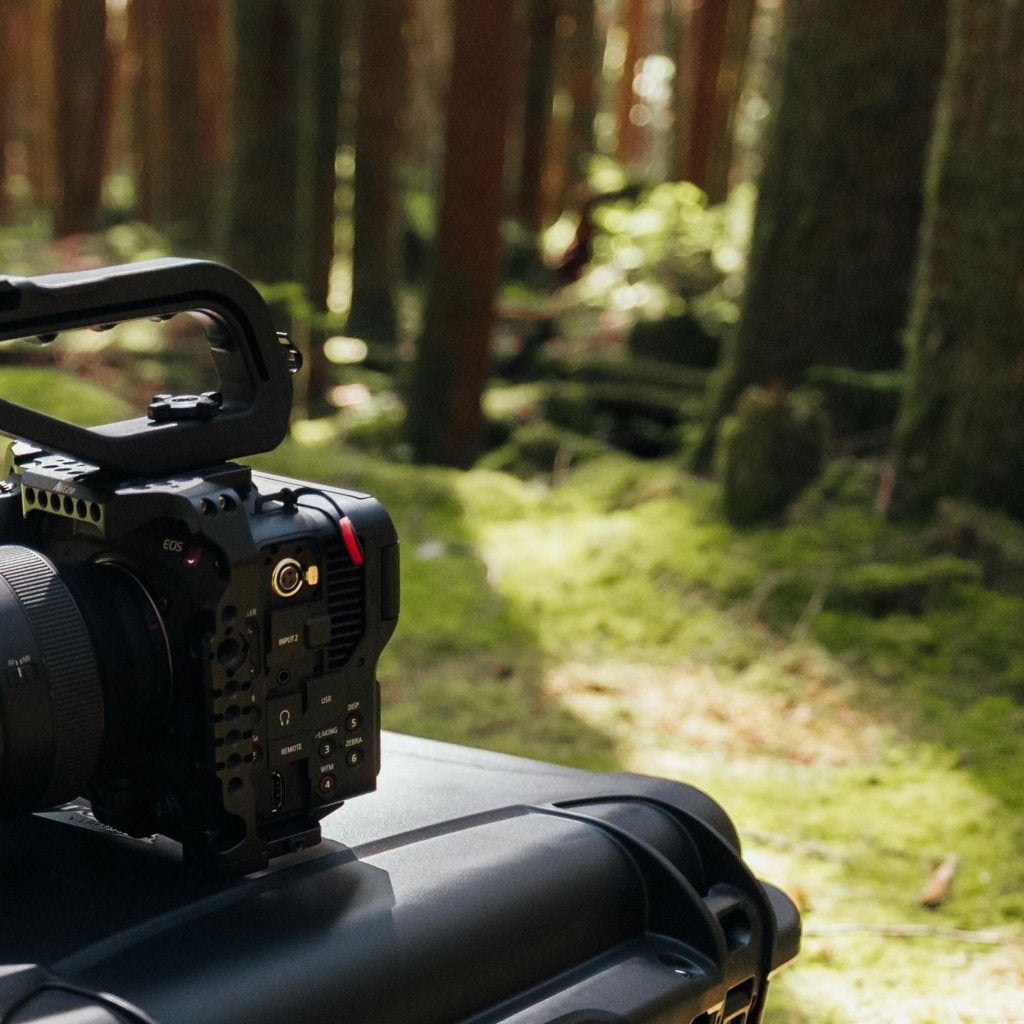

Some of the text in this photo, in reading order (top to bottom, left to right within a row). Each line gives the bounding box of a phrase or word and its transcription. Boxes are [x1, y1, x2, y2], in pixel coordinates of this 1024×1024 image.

[163, 539, 184, 552] EOS
[278, 635, 294, 646] INPUT
[351, 718, 357, 728] 5
[345, 736, 363, 747] ZEBRA
[280, 742, 302, 756] REMOTE
[323, 745, 330, 754] 3
[351, 753, 357, 763] 6
[324, 780, 330, 789] 4
